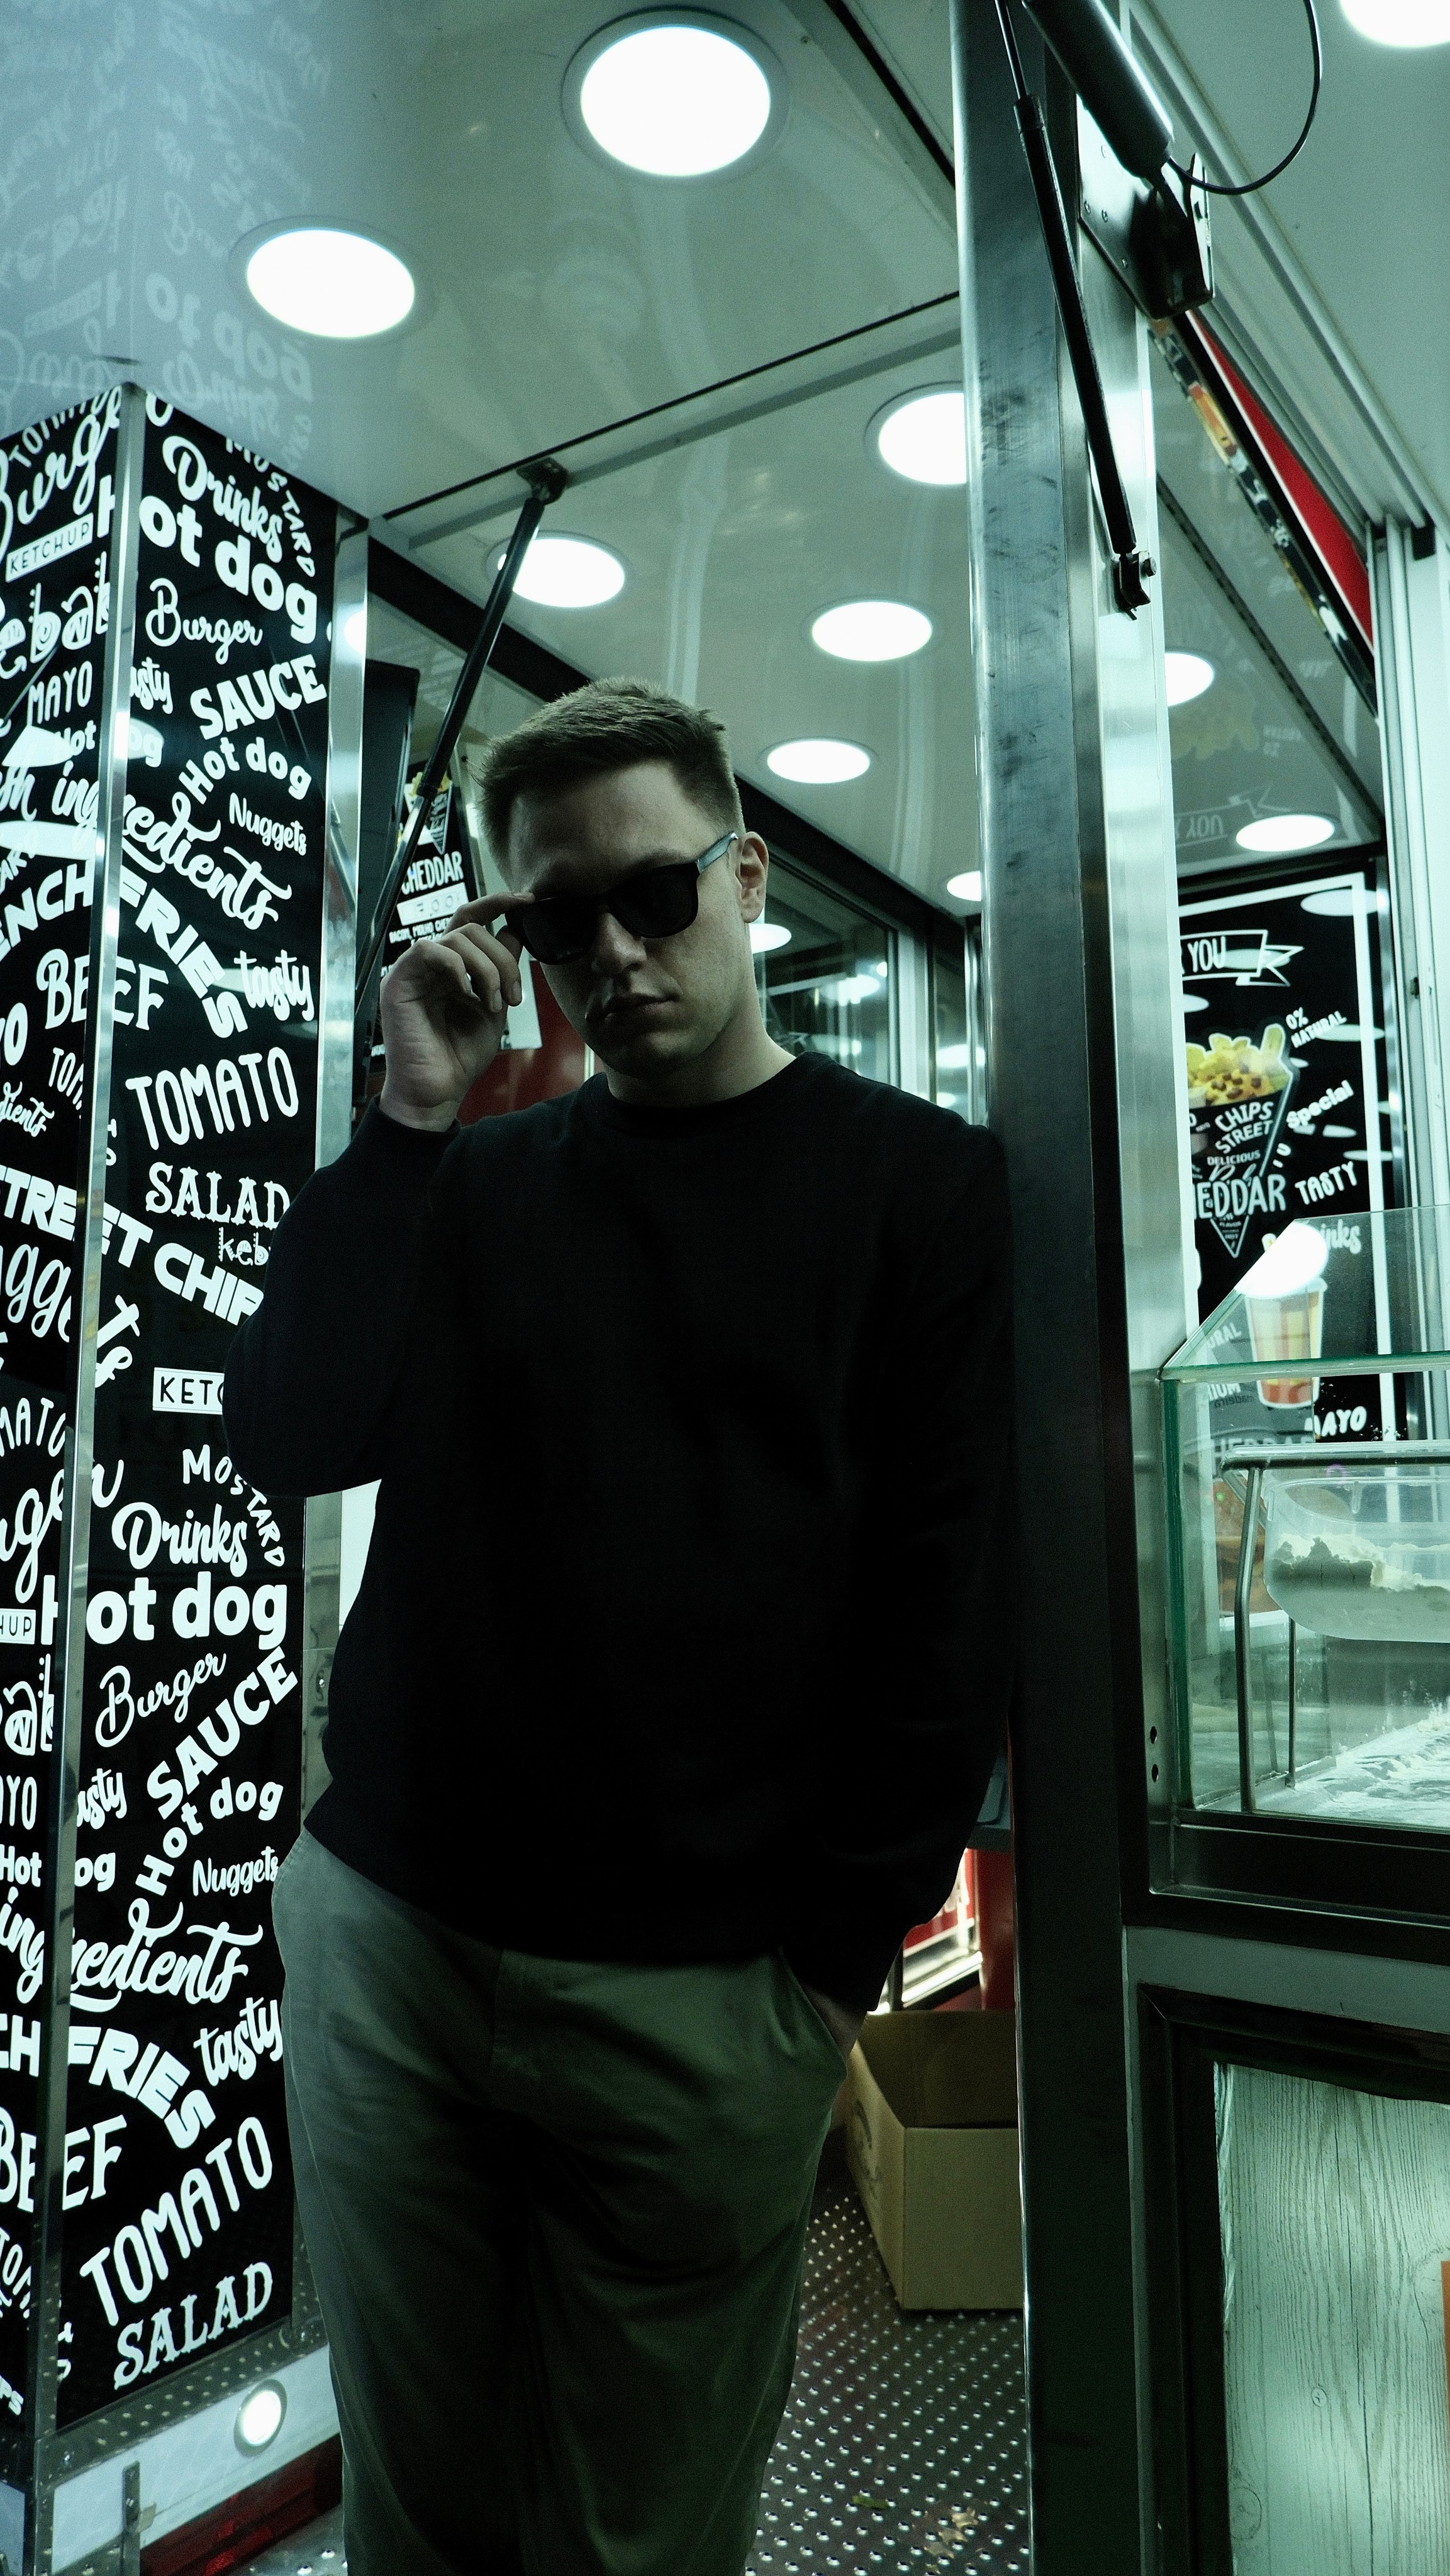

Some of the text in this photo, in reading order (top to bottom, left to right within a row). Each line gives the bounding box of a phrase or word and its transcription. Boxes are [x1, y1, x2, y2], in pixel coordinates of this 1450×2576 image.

[162, 436, 282, 563] Drinks
[9, 521, 89, 574] KETCHUP
[145, 577, 263, 665] Burger
[215, 535, 317, 644] dog
[27, 660, 93, 727] MAYO
[190, 654, 327, 740] SAUCE
[179, 737, 311, 805] Hot dog
[230, 793, 306, 855] Nuggets
[234, 950, 315, 1021] tasty
[1187, 936, 1226, 973] YOU
[1291, 1011, 1347, 1048] NATURAL
[125, 1046, 299, 1150] TOMATO
[1215, 1101, 1274, 1132] CHIPS
[1286, 1079, 1354, 1129] Special
[1207, 1150, 1261, 1166] DELICIOUS
[1215, 1120, 1274, 1154] STREET
[145, 1162, 291, 1231] SALAD
[1191, 1174, 1286, 1220] EDDAR
[1295, 1161, 1358, 1205] TASTY
[218, 1226, 270, 1266] keb
[112, 1501, 247, 1577] Drinks
[182, 1444, 285, 1567] MOSTARD
[172, 1571, 287, 1650] dog
[96, 1653, 226, 1748] Burger
[147, 1645, 298, 1820] SAUCE
[135, 1777, 284, 1896] Hot dog
[193, 1846, 279, 1897] Nuggets
[194, 1997, 284, 2087] tasty
[79, 2116, 273, 2326] TOMATO
[114, 2262, 273, 2390] SALAD
